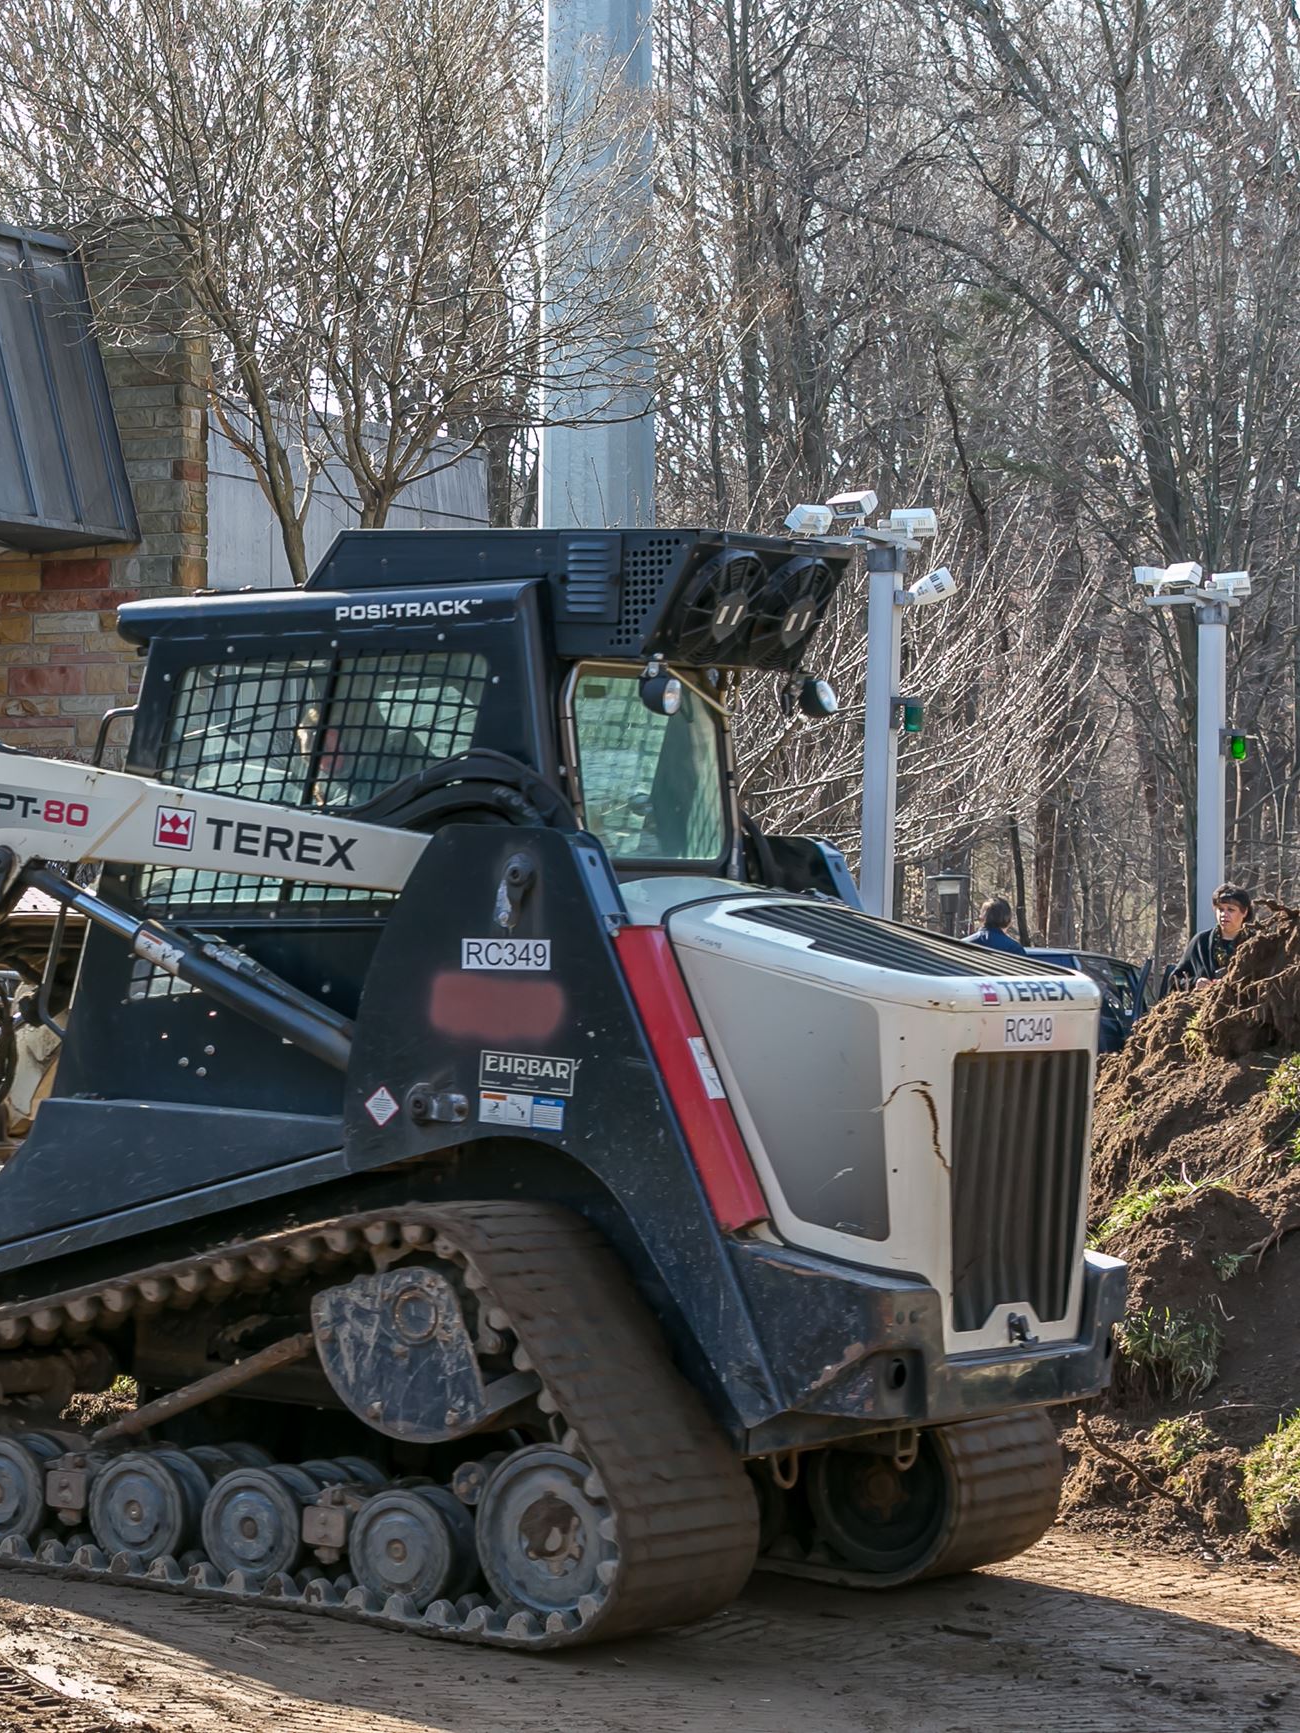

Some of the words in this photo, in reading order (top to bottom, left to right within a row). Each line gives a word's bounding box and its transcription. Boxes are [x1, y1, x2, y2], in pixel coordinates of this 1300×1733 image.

[206, 817, 359, 872] TEREX
[466, 941, 547, 967] RC349
[997, 981, 1074, 1001] TEREX
[1006, 1018, 1052, 1042] RC349
[484, 1055, 570, 1079] EHRBAR
